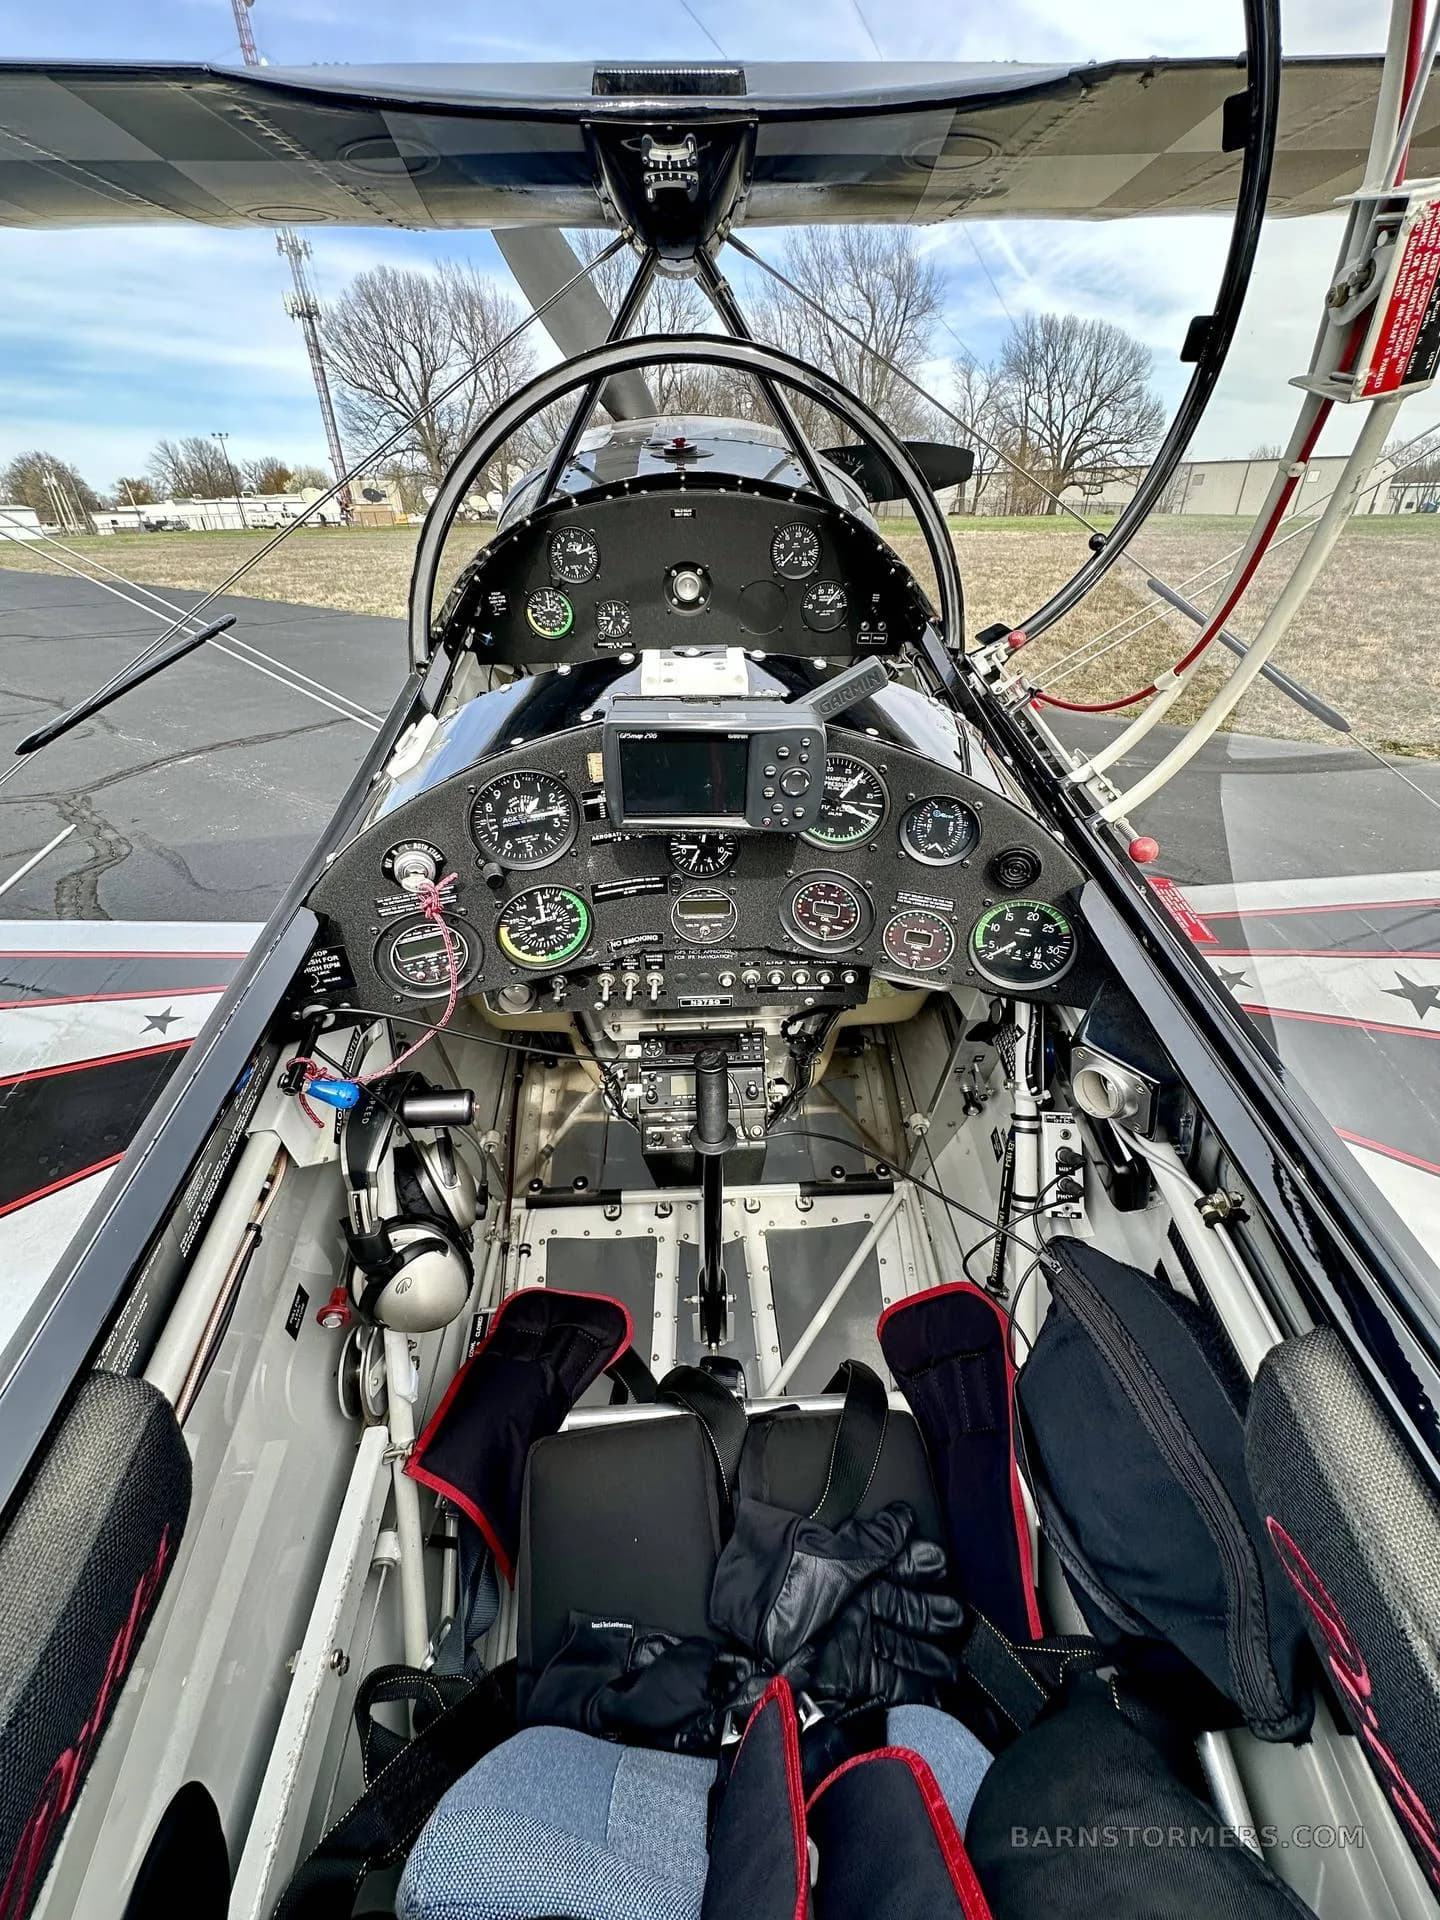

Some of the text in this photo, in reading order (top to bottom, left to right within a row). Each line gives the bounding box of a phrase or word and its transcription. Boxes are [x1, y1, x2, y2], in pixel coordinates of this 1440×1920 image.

[1411, 253, 1422, 268] OR
[1417, 250, 1432, 281] WHEN
[1392, 235, 1419, 300] UNATTENDED.
[1401, 270, 1417, 300] WHEN
[1402, 284, 1422, 325] STARTING
[1395, 253, 1440, 375] KEEP CANOPY CLOSED AND
[1387, 303, 1407, 344] AIRCRAFT
[1392, 328, 1408, 358] ENGINE
[1384, 347, 1393, 356] IS
[1373, 357, 1390, 388] PARKED
[818, 671, 882, 715] GARMIN
[513, 779, 521, 790] 0
[492, 789, 501, 800] 9
[548, 792, 556, 803] 2
[484, 802, 493, 813] 8
[552, 817, 561, 828] 3
[492, 831, 499, 842] 7
[544, 832, 552, 841] 4
[504, 839, 513, 850] 6
[525, 841, 534, 852] 5
[717, 846, 725, 854] 10
[1005, 912, 1014, 921] 15
[1026, 911, 1040, 922] 20
[990, 922, 1000, 932] 10
[1041, 923, 1055, 934] 25
[610, 934, 659, 949] NO SMOKING
[988, 940, 995, 949] 5
[1046, 945, 1060, 955] 30
[322, 955, 340, 963] FOR
[1030, 960, 1043, 969] 35
[323, 961, 341, 970] RPM
[343, 1031, 362, 1070] HROTTLE
